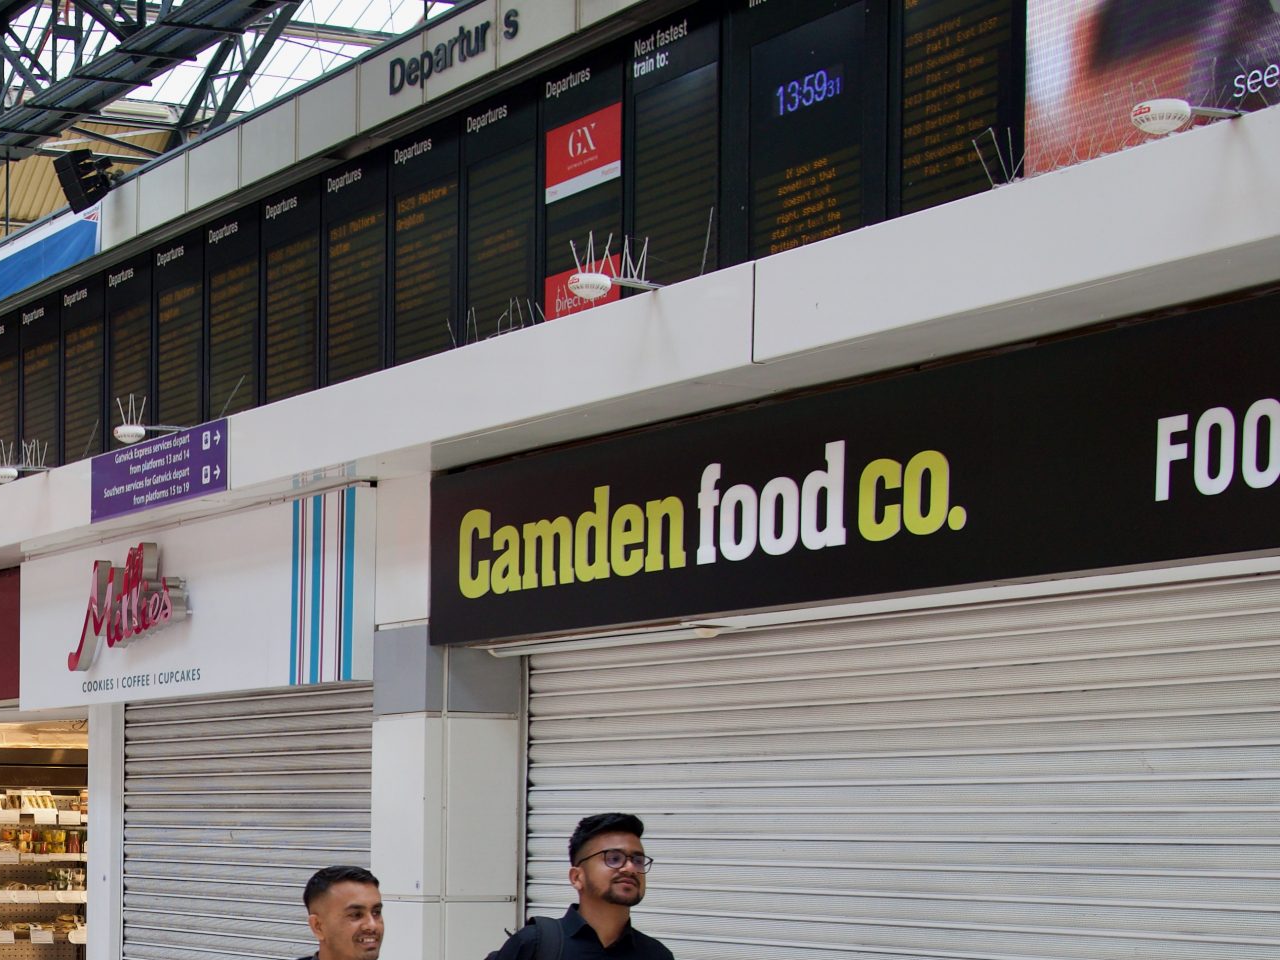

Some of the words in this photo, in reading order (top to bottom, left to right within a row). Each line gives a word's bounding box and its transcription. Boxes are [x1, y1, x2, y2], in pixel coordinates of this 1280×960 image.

[634, 35, 655, 58] Next
[656, 18, 688, 48] fastest
[633, 56, 654, 78] train
[656, 51, 669, 69] to:
[546, 67, 591, 98] Departures
[1232, 63, 1280, 98] see
[466, 104, 508, 133] Departures
[394, 137, 433, 165] Departures
[327, 168, 362, 193] Departures
[265, 196, 297, 220] Departures
[208, 221, 238, 244] Departures
[157, 245, 184, 267] Departures
[109, 267, 134, 288] Departures
[64, 287, 88, 308] Departures
[22, 306, 45, 325] Departures
[115, 450, 134, 464] Gatwick
[134, 446, 153, 459] Express
[152, 440, 173, 453] services
[173, 433, 190, 449] depart
[129, 464, 142, 475] from
[142, 458, 166, 474] platforms
[165, 455, 172, 465] 13
[172, 452, 183, 462] and
[183, 448, 190, 459] 14
[1155, 397, 1280, 502] FOO
[103, 485, 125, 499] Southern
[125, 480, 145, 494] services
[144, 477, 152, 487] for
[152, 472, 173, 485] Gatwick
[173, 467, 190, 482] depart
[133, 495, 145, 505] from
[145, 488, 169, 505] platforms
[169, 486, 176, 496] 15
[176, 485, 182, 494] to
[183, 482, 190, 493] 19
[458, 485, 687, 599] Camden
[697, 439, 846, 565] food
[857, 449, 967, 542] co.
[82, 678, 114, 693] COOKIES
[121, 674, 150, 688] COFFEE
[158, 668, 201, 684] CUPCAKES
